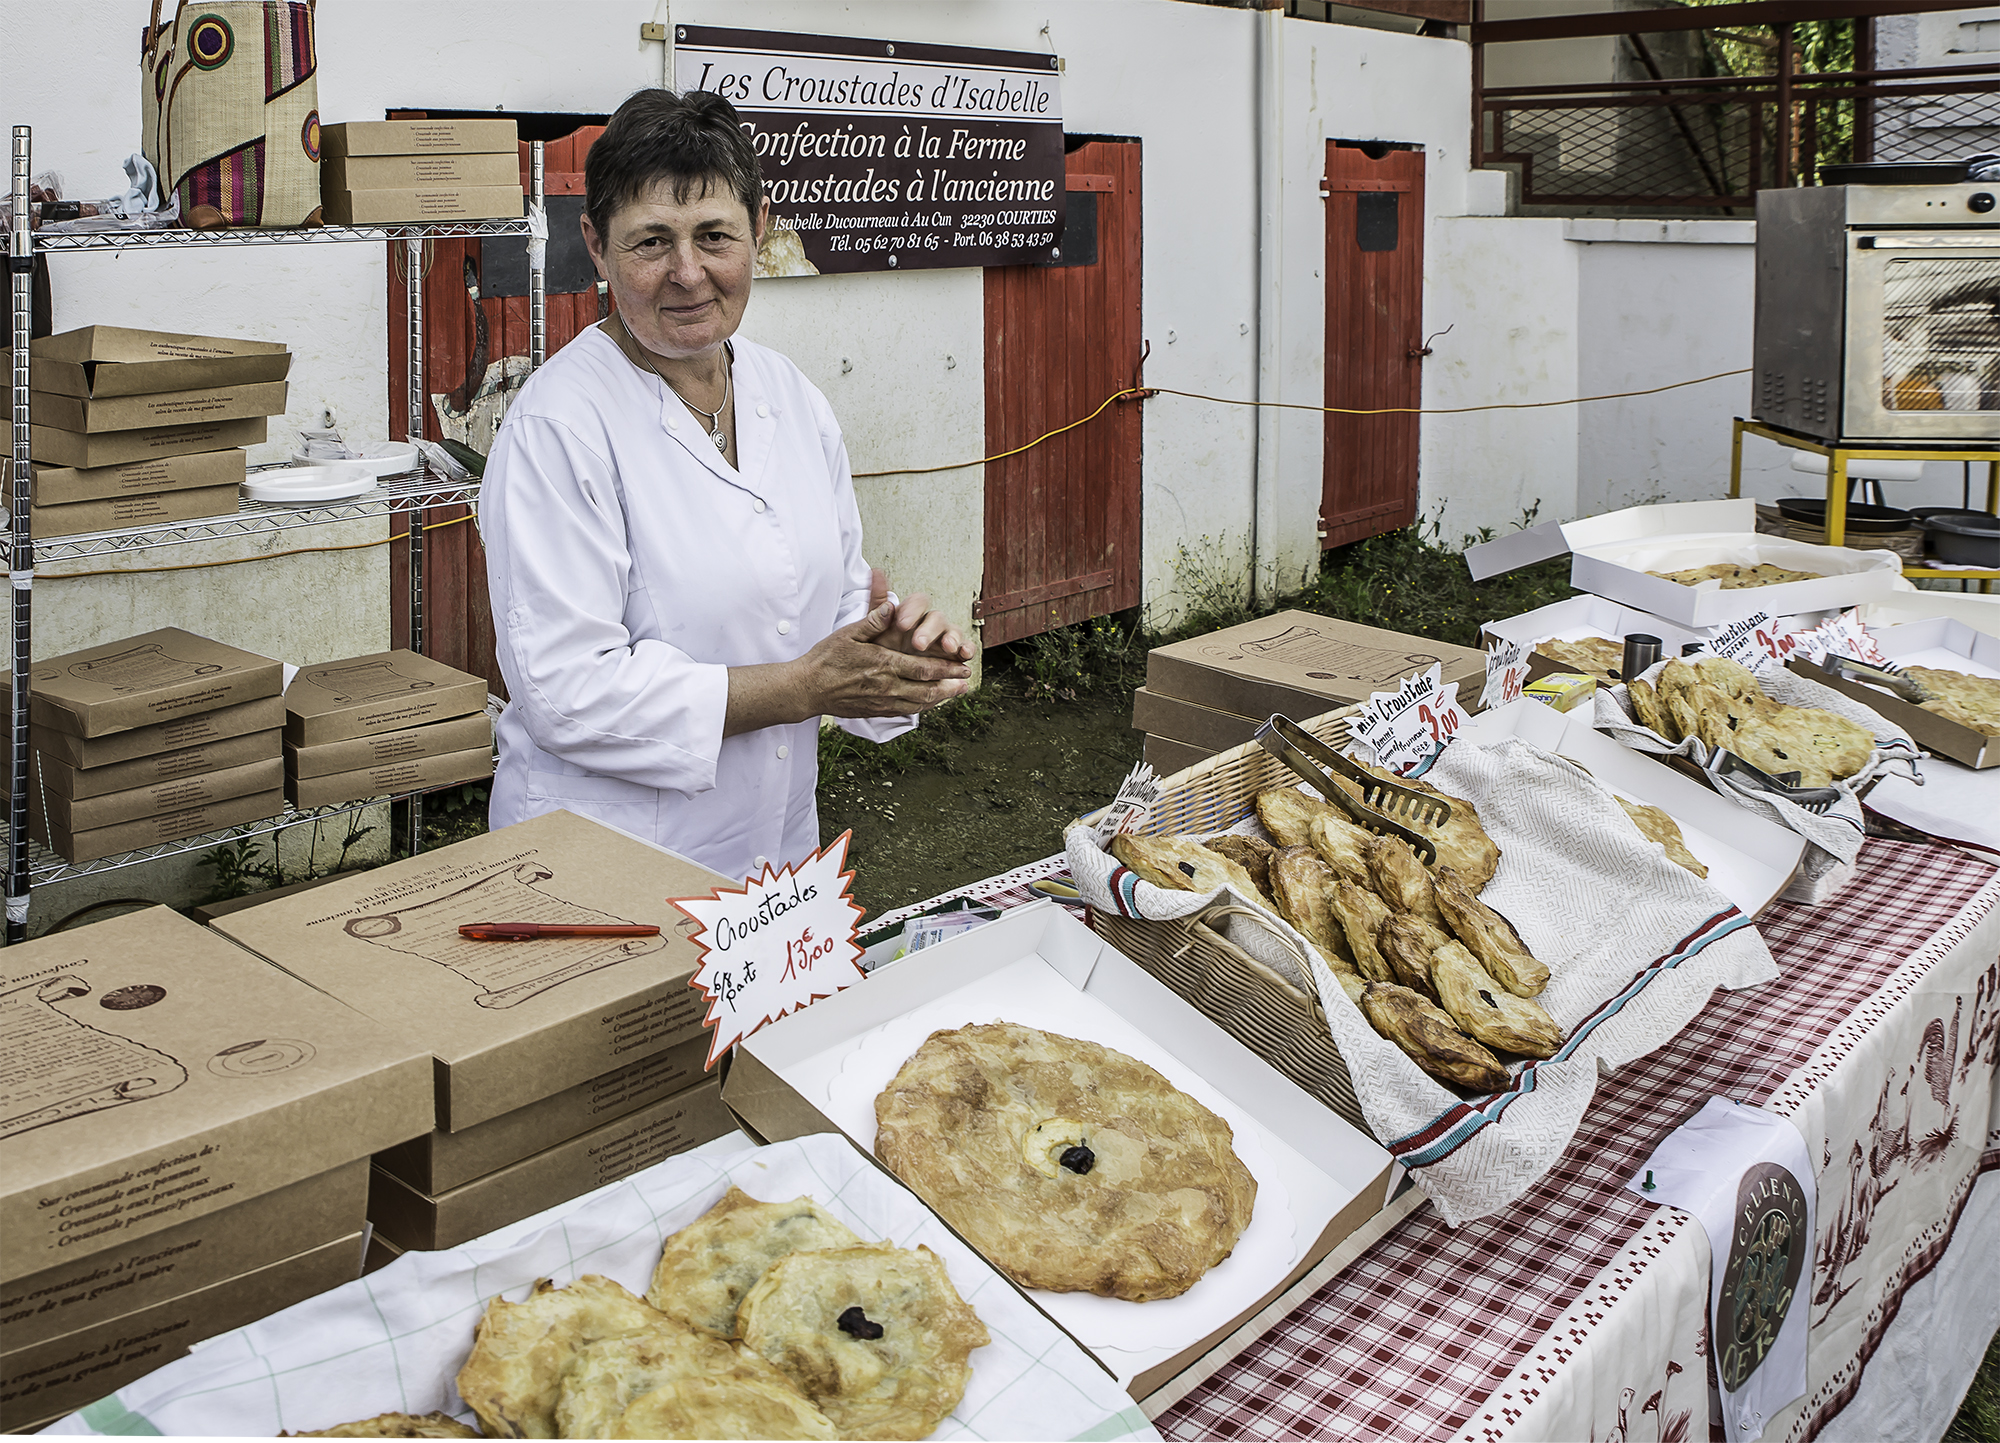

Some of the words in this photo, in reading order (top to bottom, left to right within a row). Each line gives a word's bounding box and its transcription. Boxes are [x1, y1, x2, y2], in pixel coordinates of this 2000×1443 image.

[699, 62, 752, 100] Les
[762, 66, 923, 107] Croustades
[931, 75, 1049, 113] d'Isabelle
[894, 124, 912, 159] à
[917, 125, 941, 159] la
[945, 129, 1027, 160] Ferme
[761, 168, 901, 204] roustades
[906, 168, 925, 202] à
[931, 169, 1055, 202] l'ancienne
[773, 212, 823, 231] Isabelle
[824, 212, 899, 230] Ducourneau
[900, 211, 909, 227] à
[910, 211, 929, 227] Au
[931, 211, 952, 227] Cun
[960, 214, 995, 229] 32230
[996, 210, 1057, 226] COURTIES
[830, 233, 852, 252] Tél.
[855, 237, 872, 254] 05
[873, 234, 889, 250] 62
[888, 236, 905, 252] 70
[906, 233, 922, 249] 81
[924, 232, 940, 251] 65
[953, 231, 977, 247] Port.
[978, 231, 993, 246] 06
[994, 230, 1010, 249] 38
[1010, 233, 1025, 248] 53
[1025, 232, 1039, 247] 43
[1039, 231, 1054, 246] 50
[715, 877, 818, 951] Croustades
[37, 1196, 63, 1210] Sur
[65, 1171, 134, 1202] commande
[136, 1152, 197, 1178] confection
[199, 1144, 214, 1157] de
[58, 1189, 124, 1218] Croustade
[126, 1182, 151, 1196] aux
[151, 1164, 202, 1191] pommes
[58, 1204, 124, 1233] Croustade
[126, 1196, 151, 1211] aux
[150, 1176, 210, 1205] pruneaux
[57, 1218, 124, 1247] Croustade
[28, 1269, 111, 1301] croustades
[126, 1239, 202, 1269] l'ancienne
[37, 1298, 57, 1314] de
[60, 1291, 86, 1306] ma
[87, 1272, 137, 1301] grand
[1722, 1286, 1792, 1386] GERS
